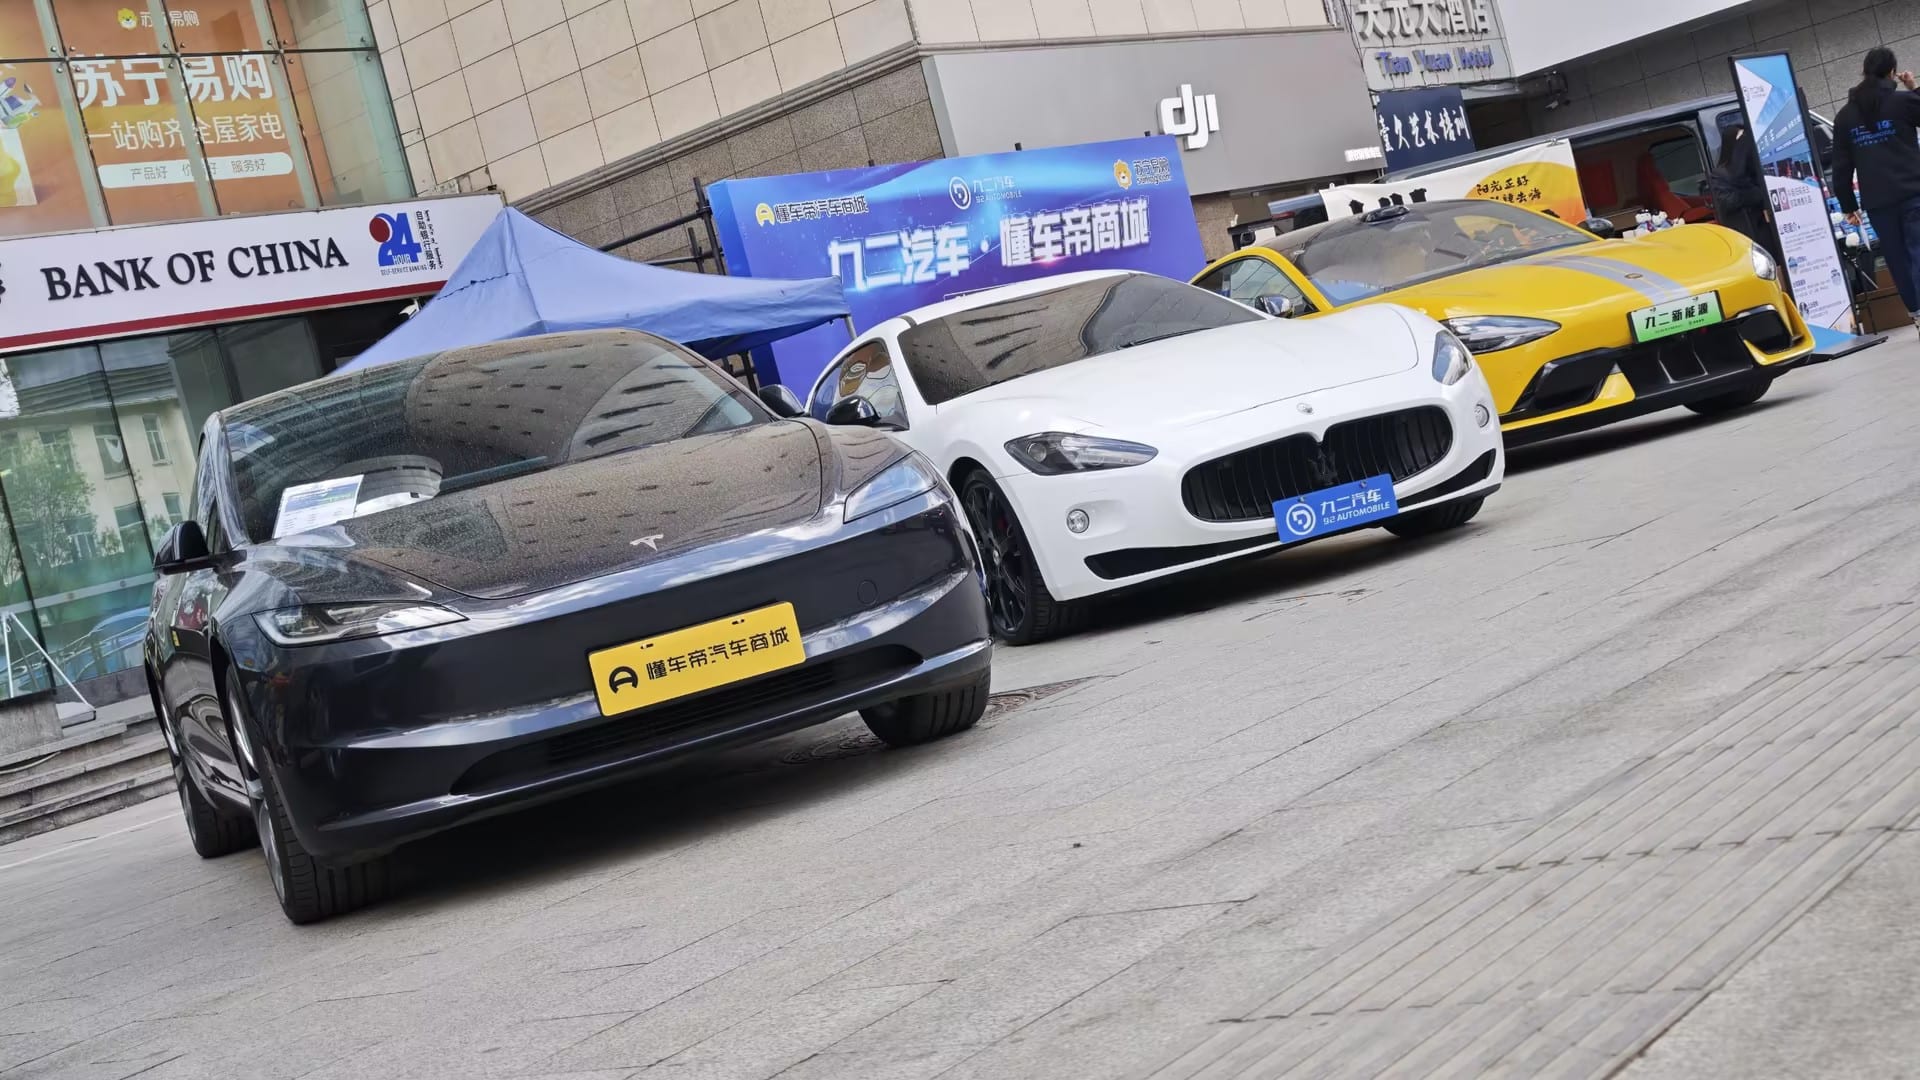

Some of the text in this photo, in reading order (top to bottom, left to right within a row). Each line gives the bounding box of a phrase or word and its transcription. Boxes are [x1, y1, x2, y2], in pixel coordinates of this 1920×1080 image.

[72, 49, 273, 109] 苏宁易购
[89, 112, 286, 150] 一站购齐全屋家电
[130, 158, 266, 181] 产品好 价好 服务好
[972, 175, 1015, 193] 九二汽车
[775, 195, 868, 223] 懂车帝汽车商城
[41, 257, 160, 300] BANK
[167, 250, 216, 285] OF
[228, 237, 349, 278] CHINA
[1645, 302, 1708, 330] 九二新能源
[1321, 488, 1382, 515] 九二汽车
[1323, 501, 1391, 525] 92 AUTOMOBILE
[646, 626, 790, 680] 懂车帝汽车商城
